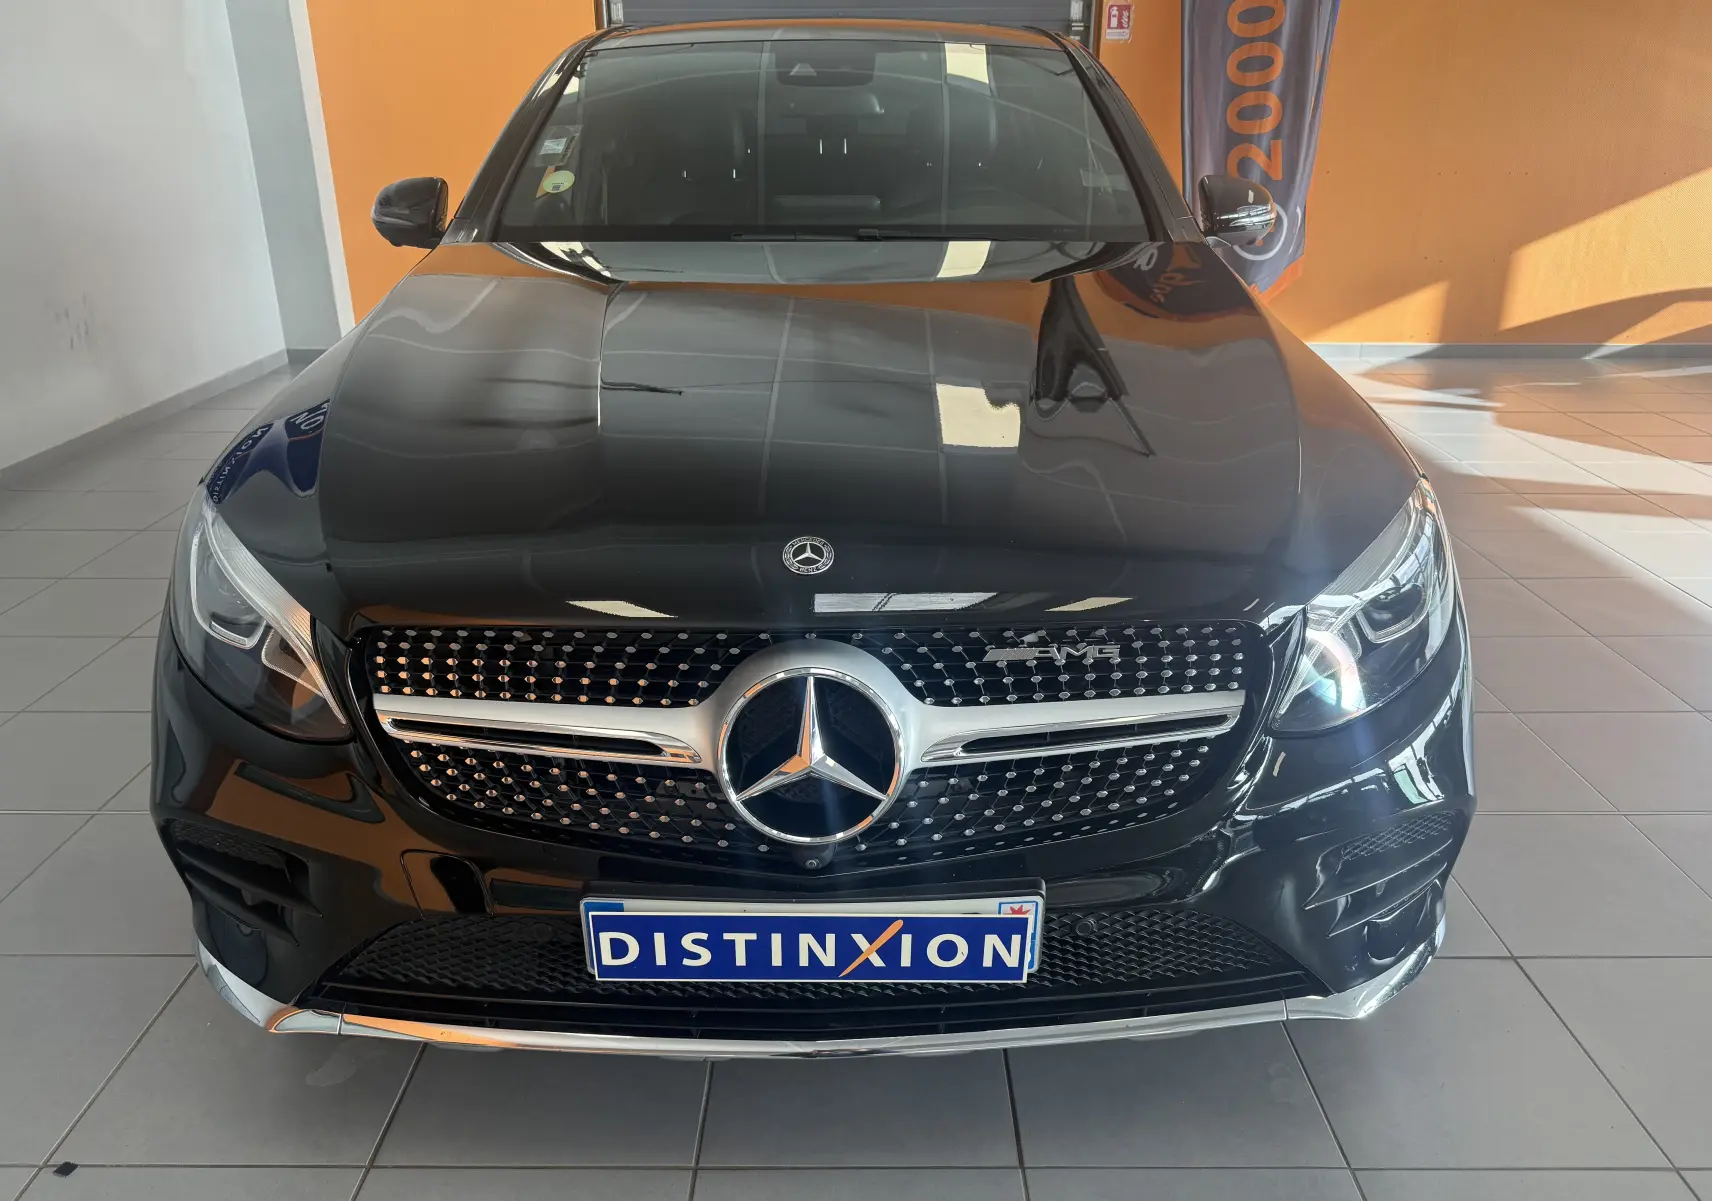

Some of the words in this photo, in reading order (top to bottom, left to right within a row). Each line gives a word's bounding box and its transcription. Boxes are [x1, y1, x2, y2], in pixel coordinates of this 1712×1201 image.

[1226, 0, 1286, 181] 2000
[1030, 644, 1121, 661] AMG
[598, 920, 1023, 977] DISTINXION
